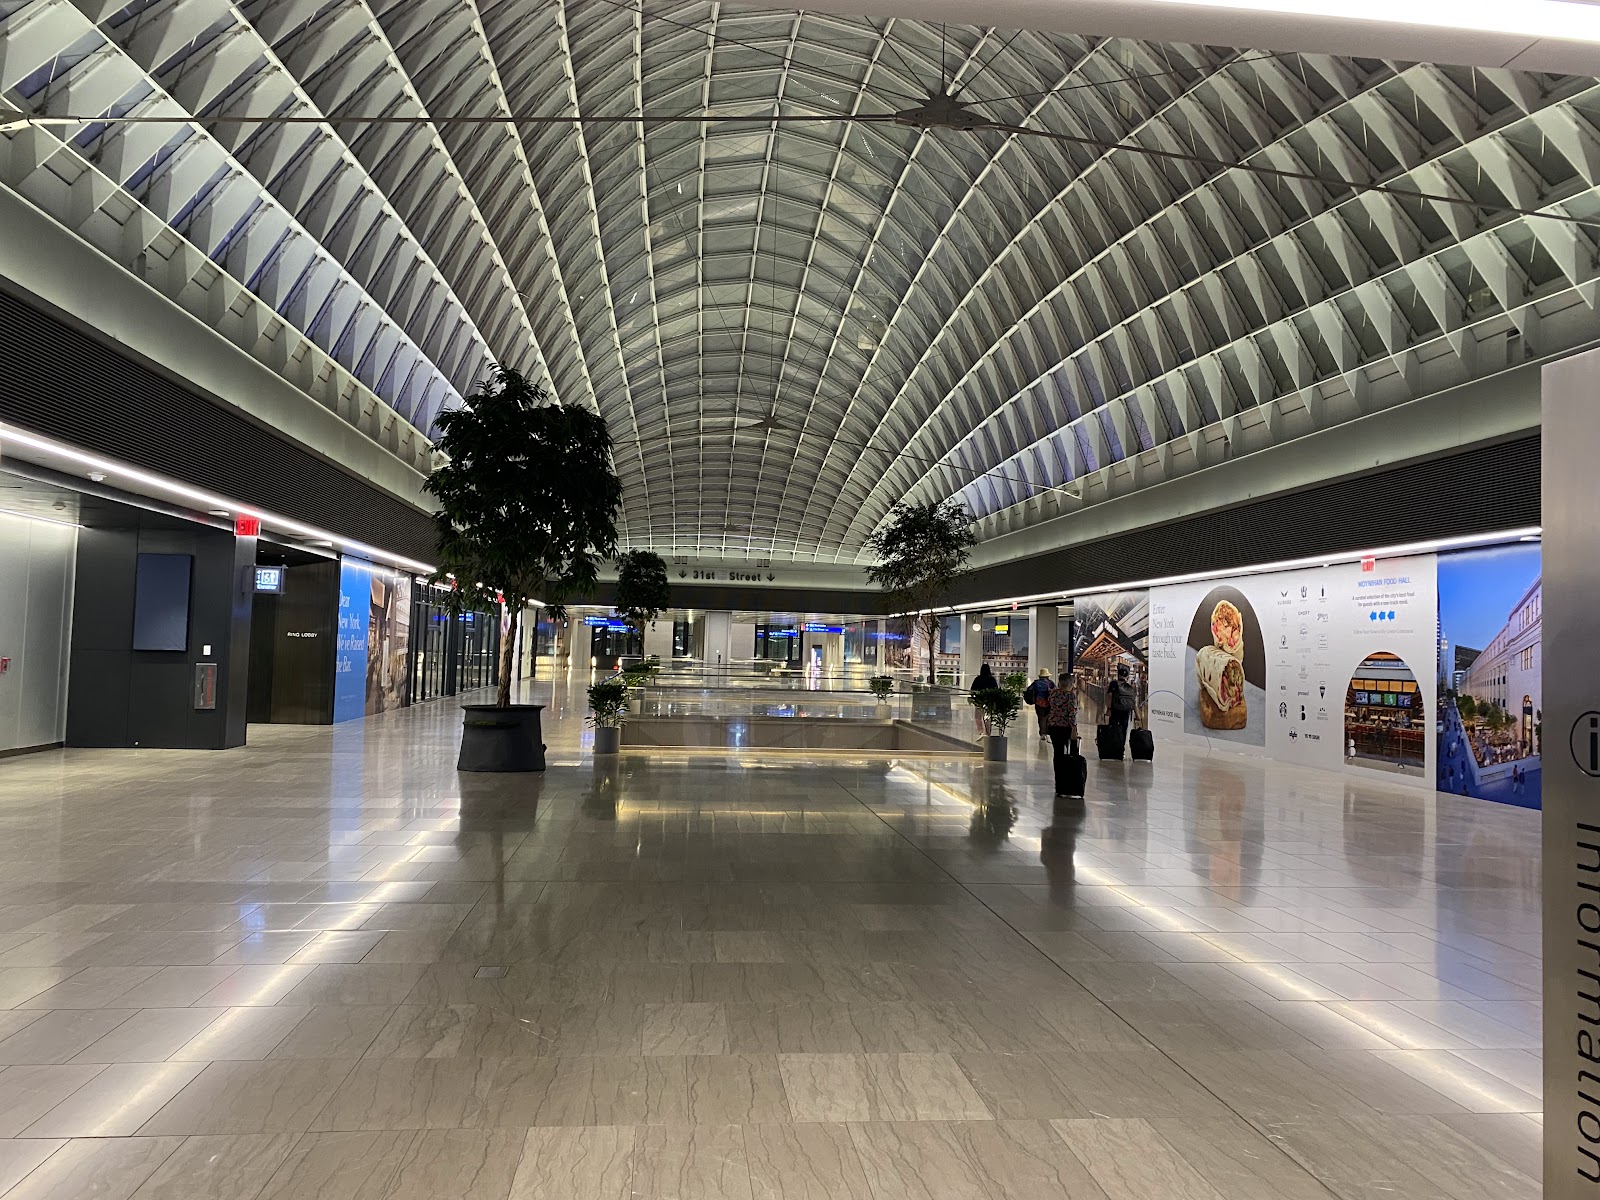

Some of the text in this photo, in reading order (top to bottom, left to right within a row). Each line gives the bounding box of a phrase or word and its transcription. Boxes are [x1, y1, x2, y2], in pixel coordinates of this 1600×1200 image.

[237, 520, 258, 536] EXIT
[693, 570, 762, 582] 31st Street
[1358, 579, 1382, 587] MOYNIHAN
[339, 590, 350, 608] Dear
[1152, 604, 1165, 614] Enter
[338, 612, 348, 629] New
[1152, 618, 1174, 628] New York
[351, 634, 365, 651] Raised
[1152, 632, 1183, 646] through your
[1152, 650, 1163, 658] taste
